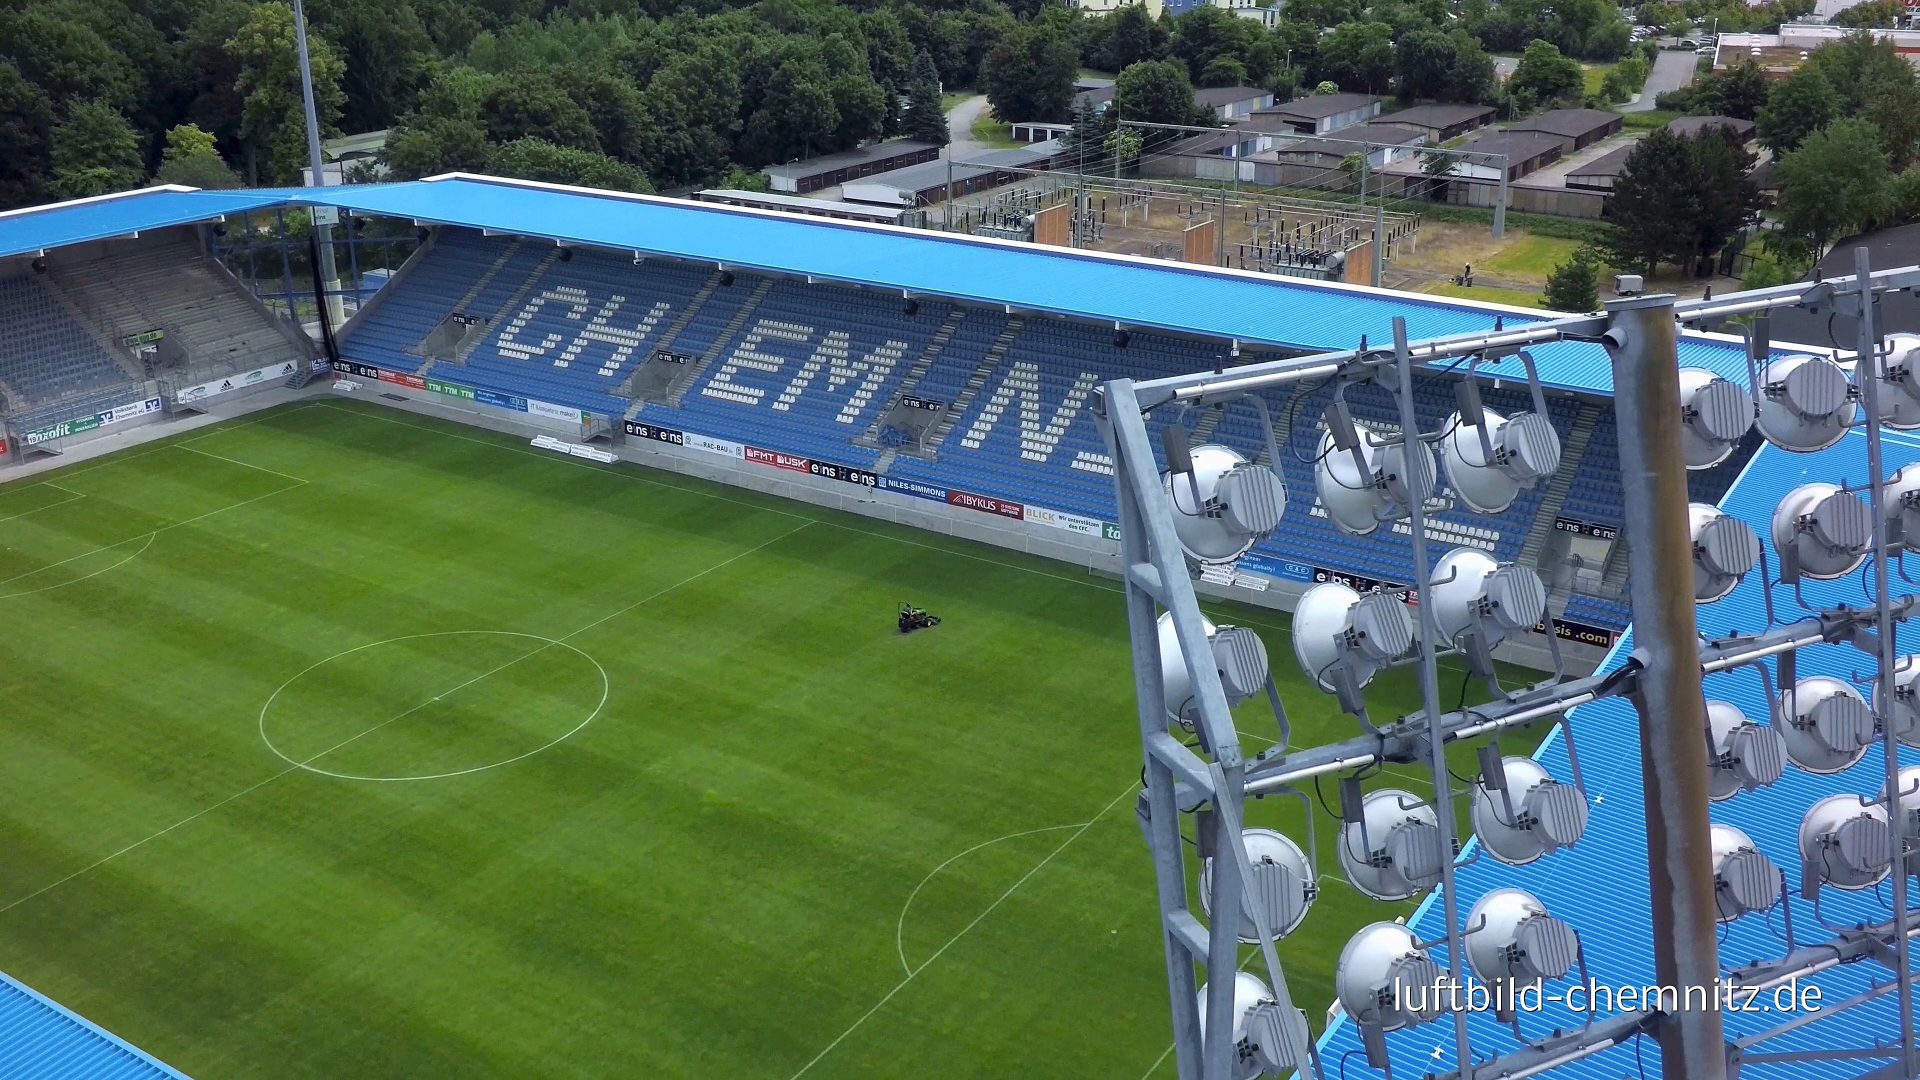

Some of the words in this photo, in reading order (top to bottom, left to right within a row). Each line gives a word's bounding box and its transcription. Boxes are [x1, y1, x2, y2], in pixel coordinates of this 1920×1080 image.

[444, 386, 458, 395] TTM
[461, 390, 475, 399] TTM
[626, 423, 648, 437] eins
[660, 431, 682, 444] eins
[811, 463, 836, 477] eins
[850, 471, 876, 486] eins
[888, 479, 946, 498] NILES-SIMMONS
[963, 495, 996, 511] IBYKUS
[1026, 508, 1056, 522] BLICK
